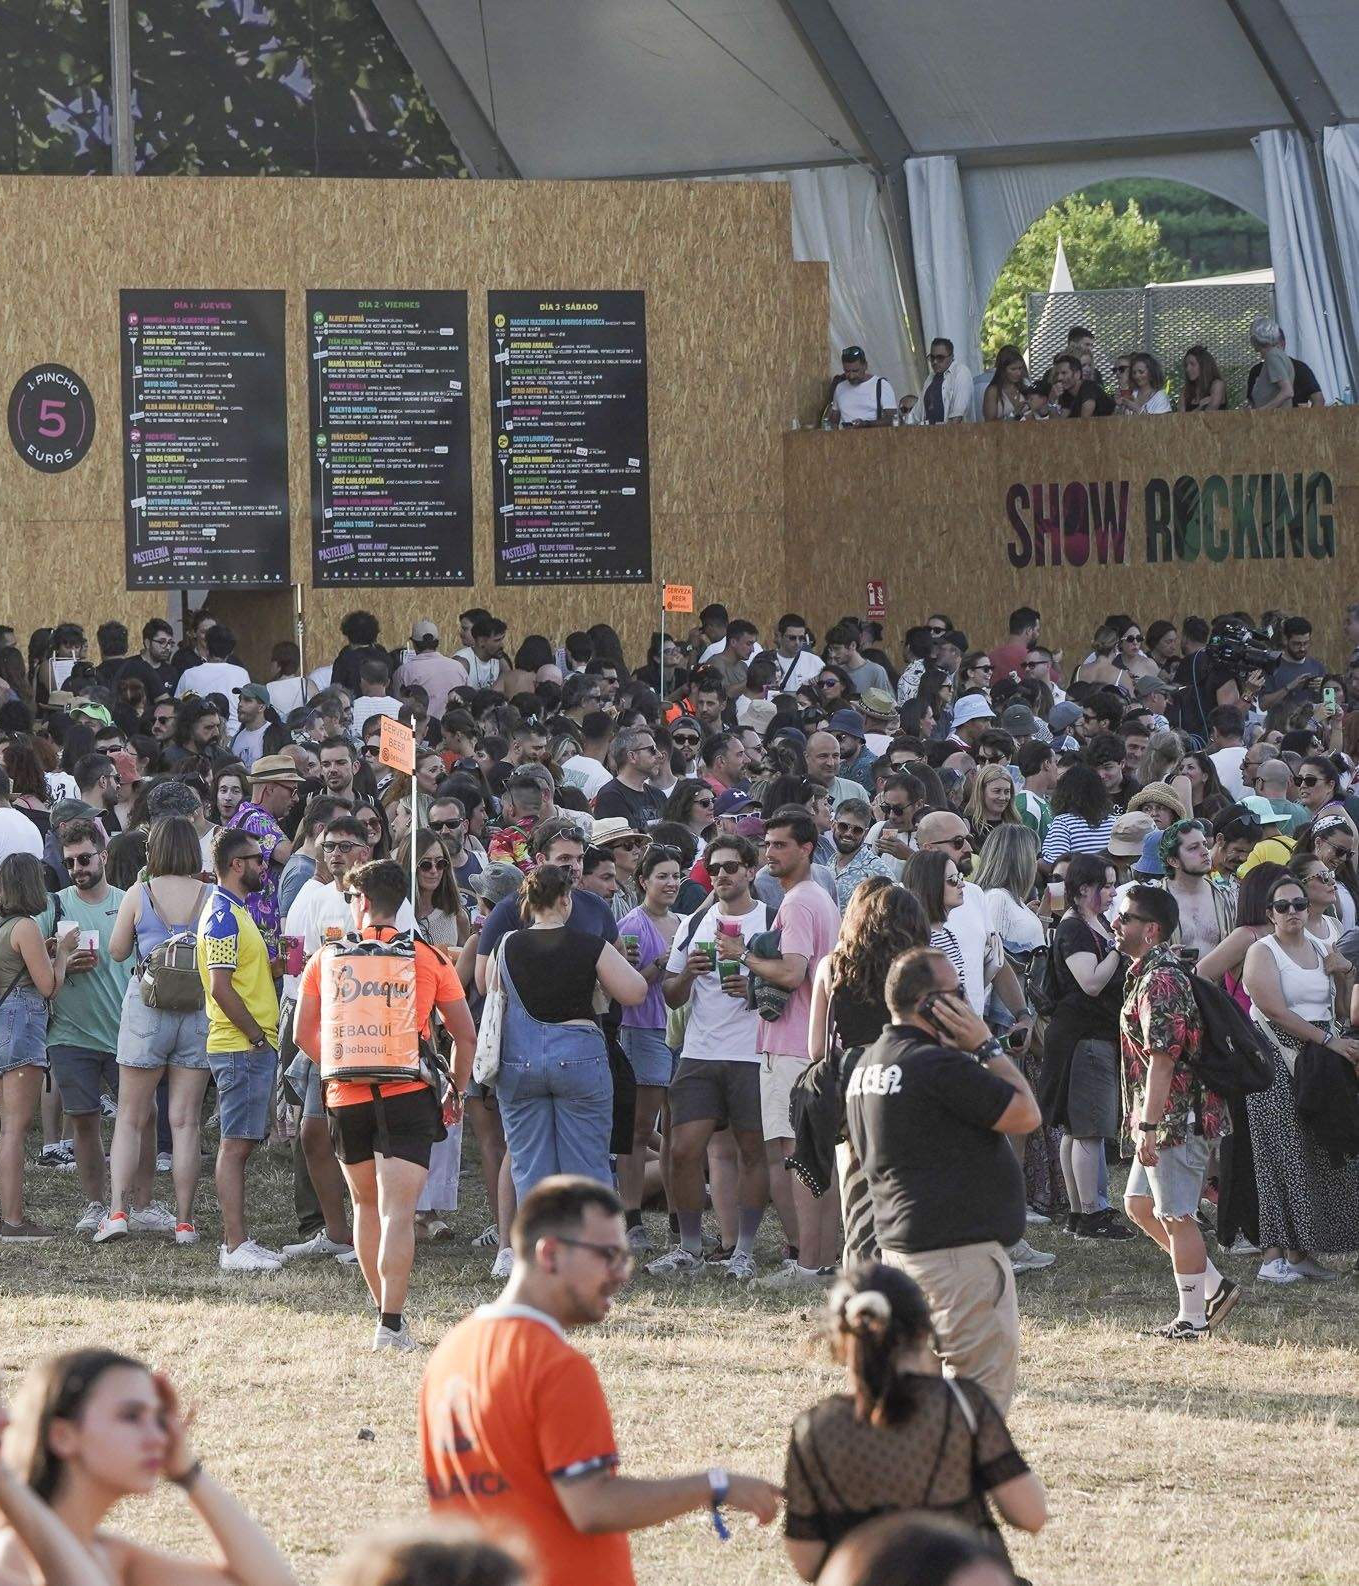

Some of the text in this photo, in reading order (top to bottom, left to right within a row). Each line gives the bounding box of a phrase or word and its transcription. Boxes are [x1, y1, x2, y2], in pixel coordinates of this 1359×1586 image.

[199, 301, 232, 309] JUEVES
[539, 302, 554, 311] DÍA
[565, 302, 598, 311] SÁBADO
[26, 372, 80, 397] 1 PINCHO
[38, 399, 66, 438] 5
[26, 444, 73, 464] EUROS
[1006, 471, 1335, 568] SHOW ROCKING
